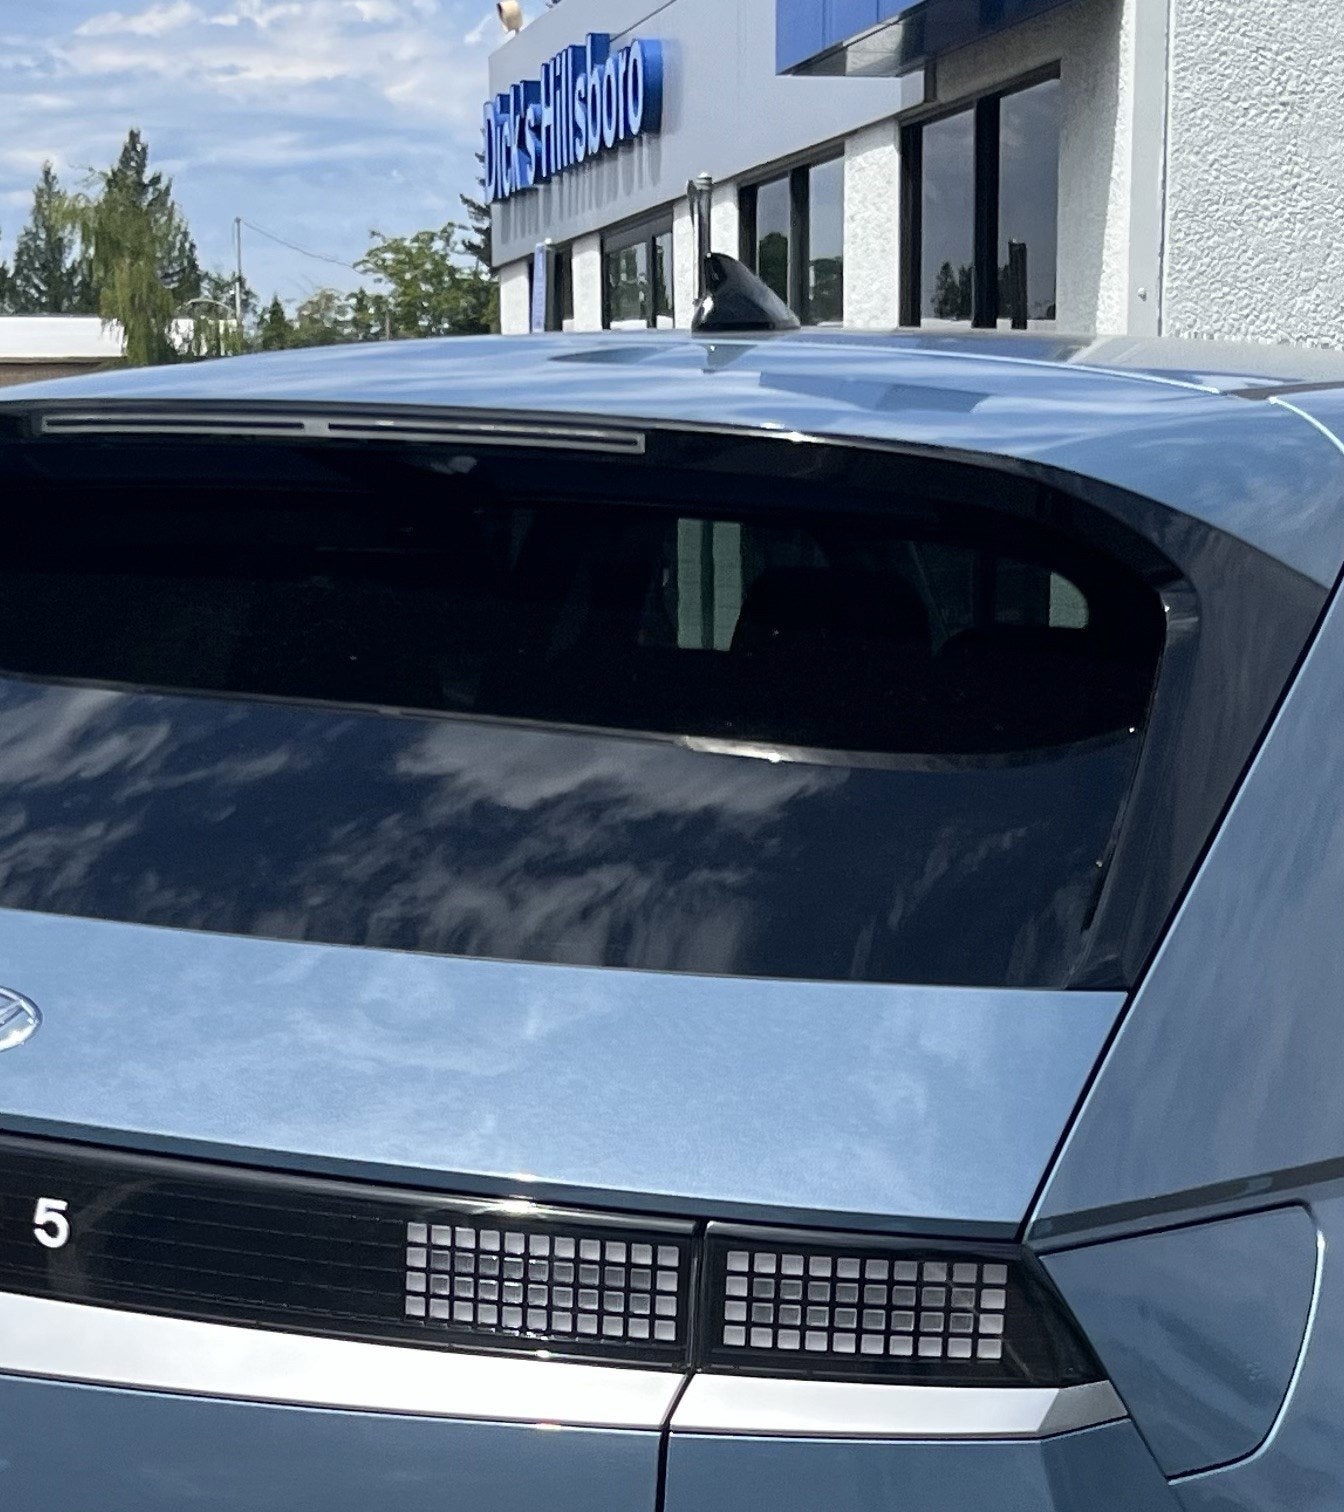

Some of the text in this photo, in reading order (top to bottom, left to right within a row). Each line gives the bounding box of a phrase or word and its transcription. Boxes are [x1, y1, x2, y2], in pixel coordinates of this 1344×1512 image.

[483, 32, 650, 205] Dick's Hillsboro
[33, 1196, 71, 1249] 5
